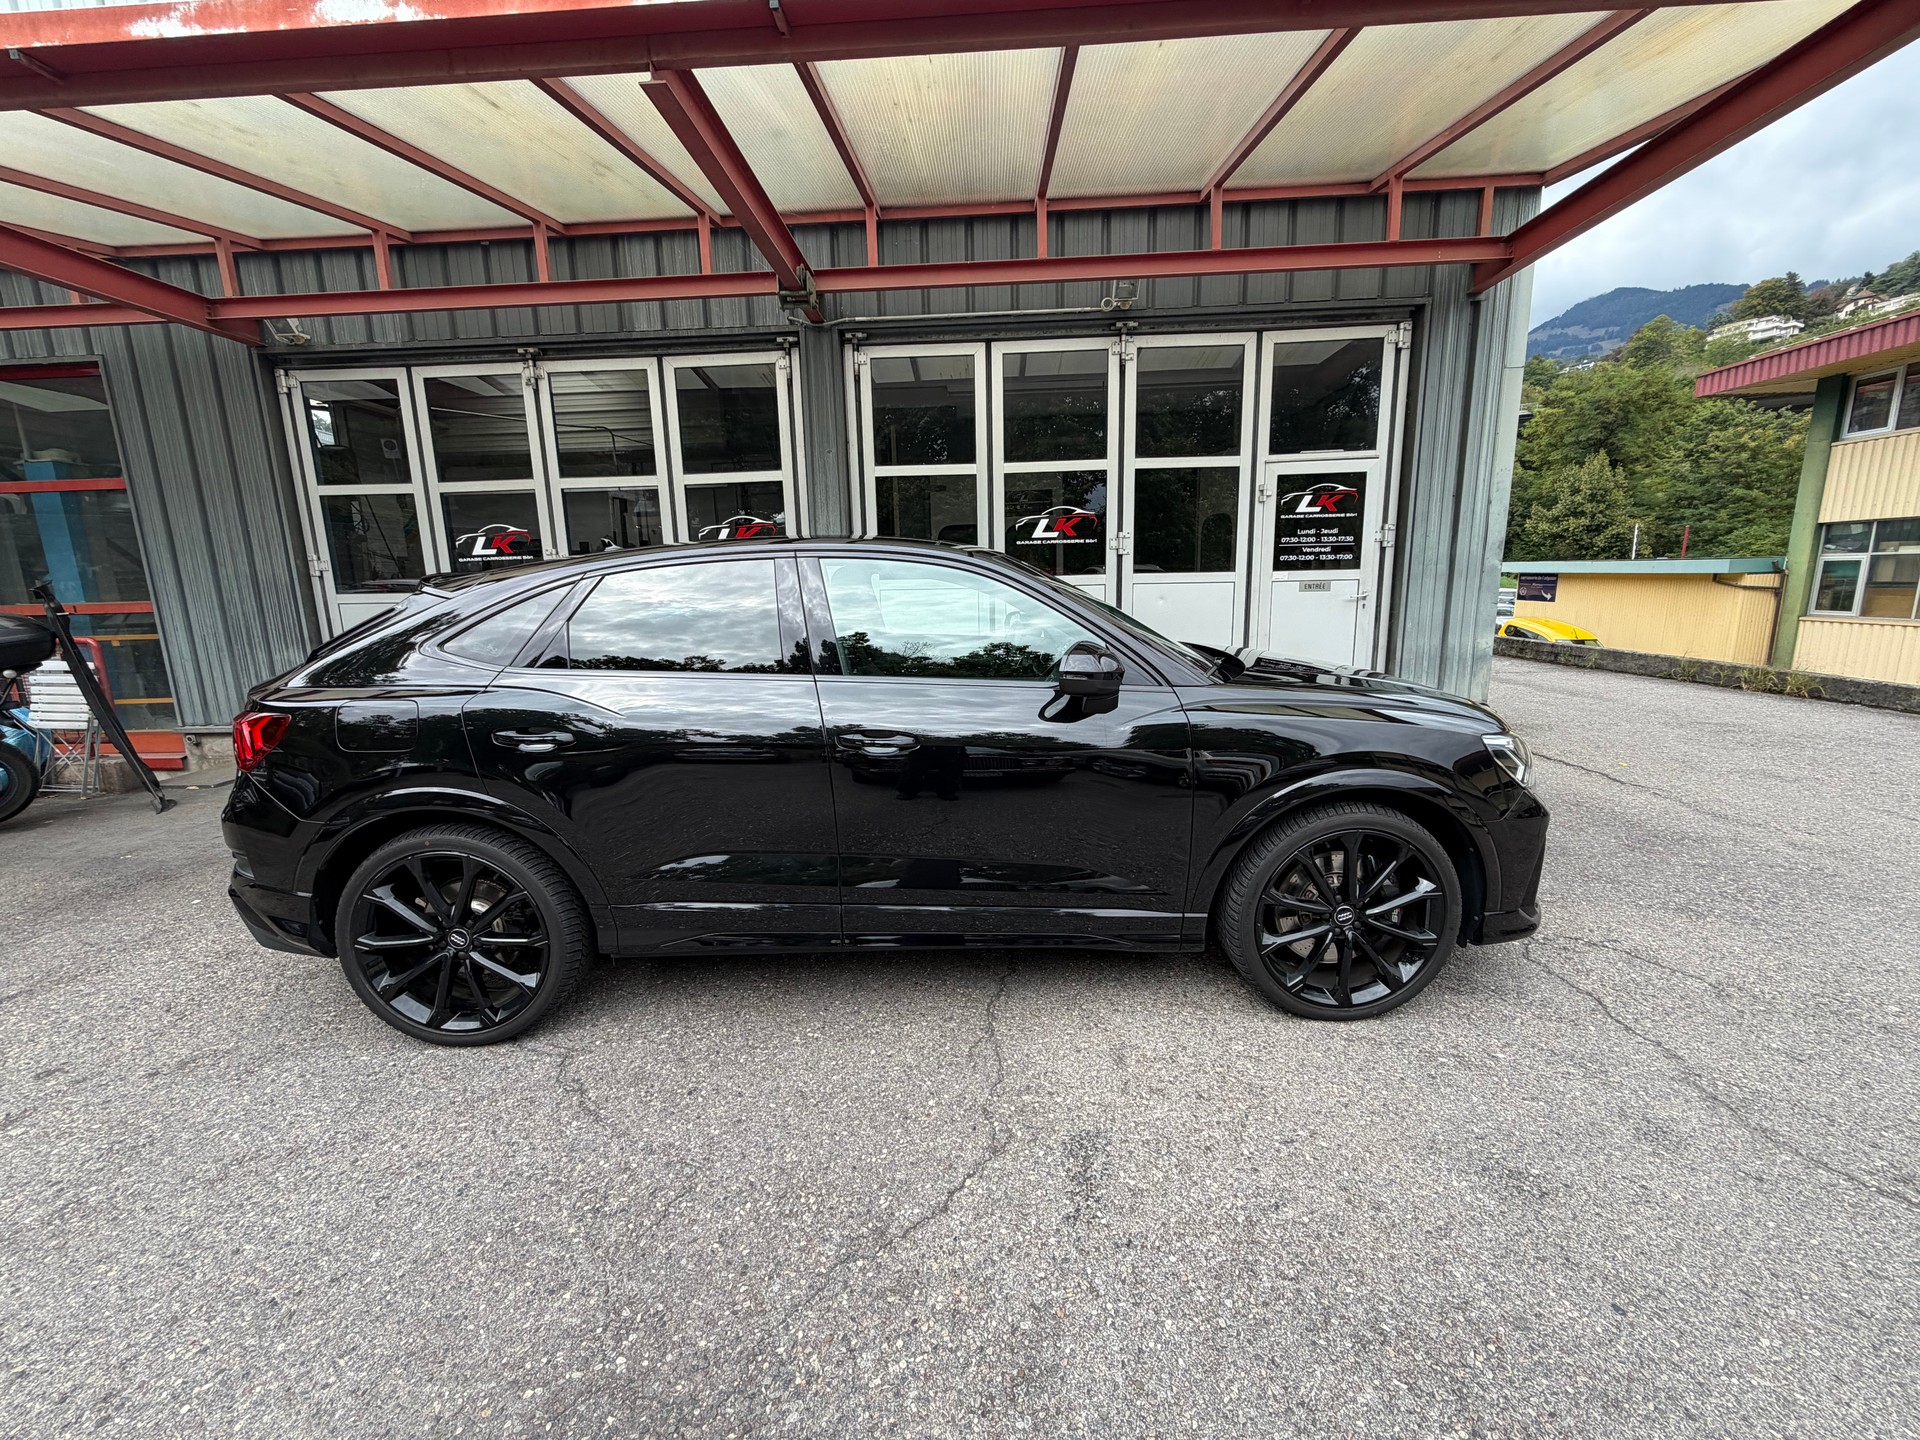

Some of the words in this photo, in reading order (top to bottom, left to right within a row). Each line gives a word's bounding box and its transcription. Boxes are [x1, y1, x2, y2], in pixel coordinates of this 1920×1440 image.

[1295, 494, 1345, 513] LK
[1031, 518, 1082, 538] LK
[472, 536, 518, 555] LK
[1304, 582, 1326, 590] ENTRÉE
